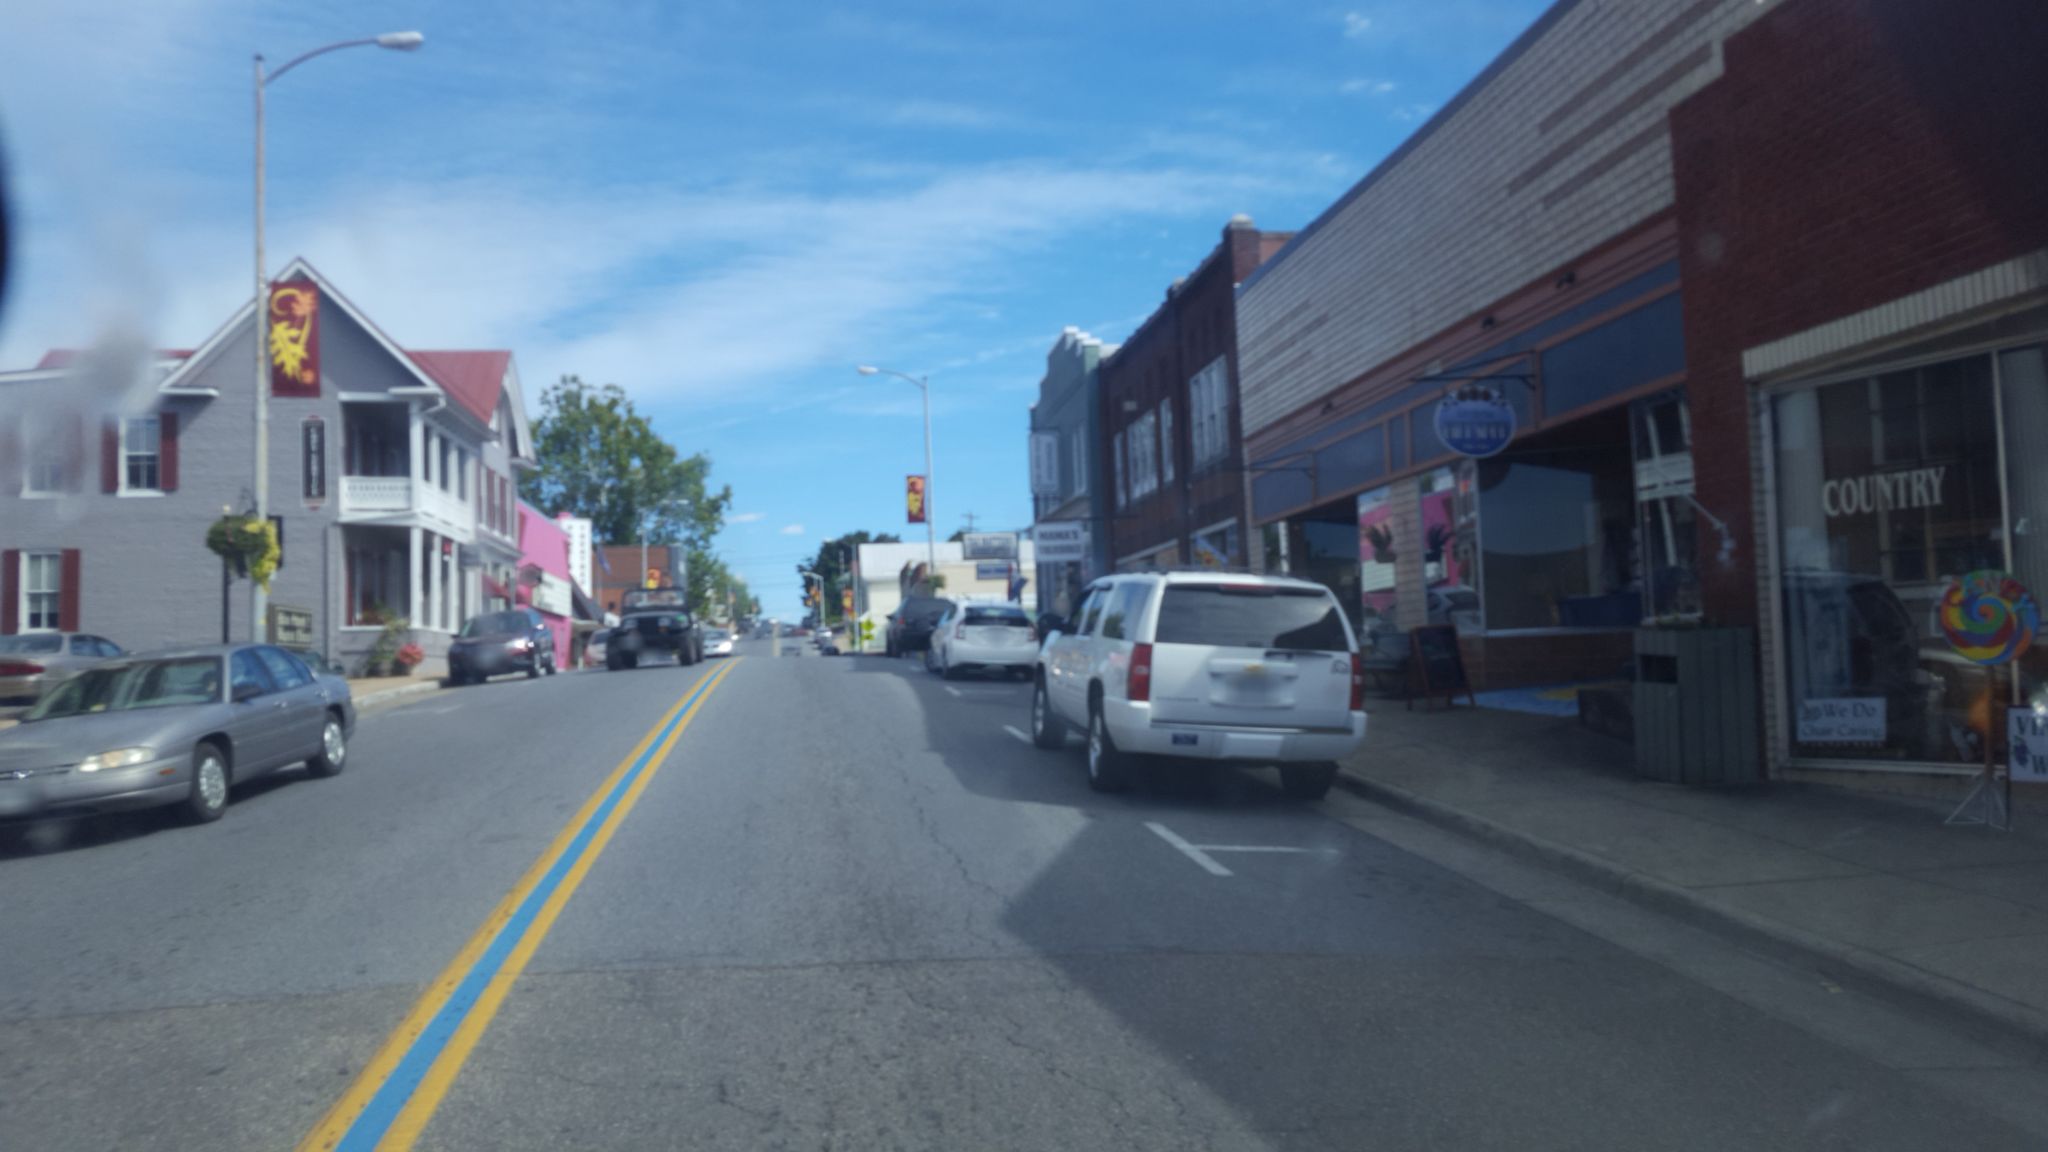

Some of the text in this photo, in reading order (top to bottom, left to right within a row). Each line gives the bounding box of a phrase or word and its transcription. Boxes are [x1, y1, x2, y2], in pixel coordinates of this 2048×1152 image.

[1822, 466, 1946, 517] COUNTRY
[1823, 702, 1878, 718] We Do
